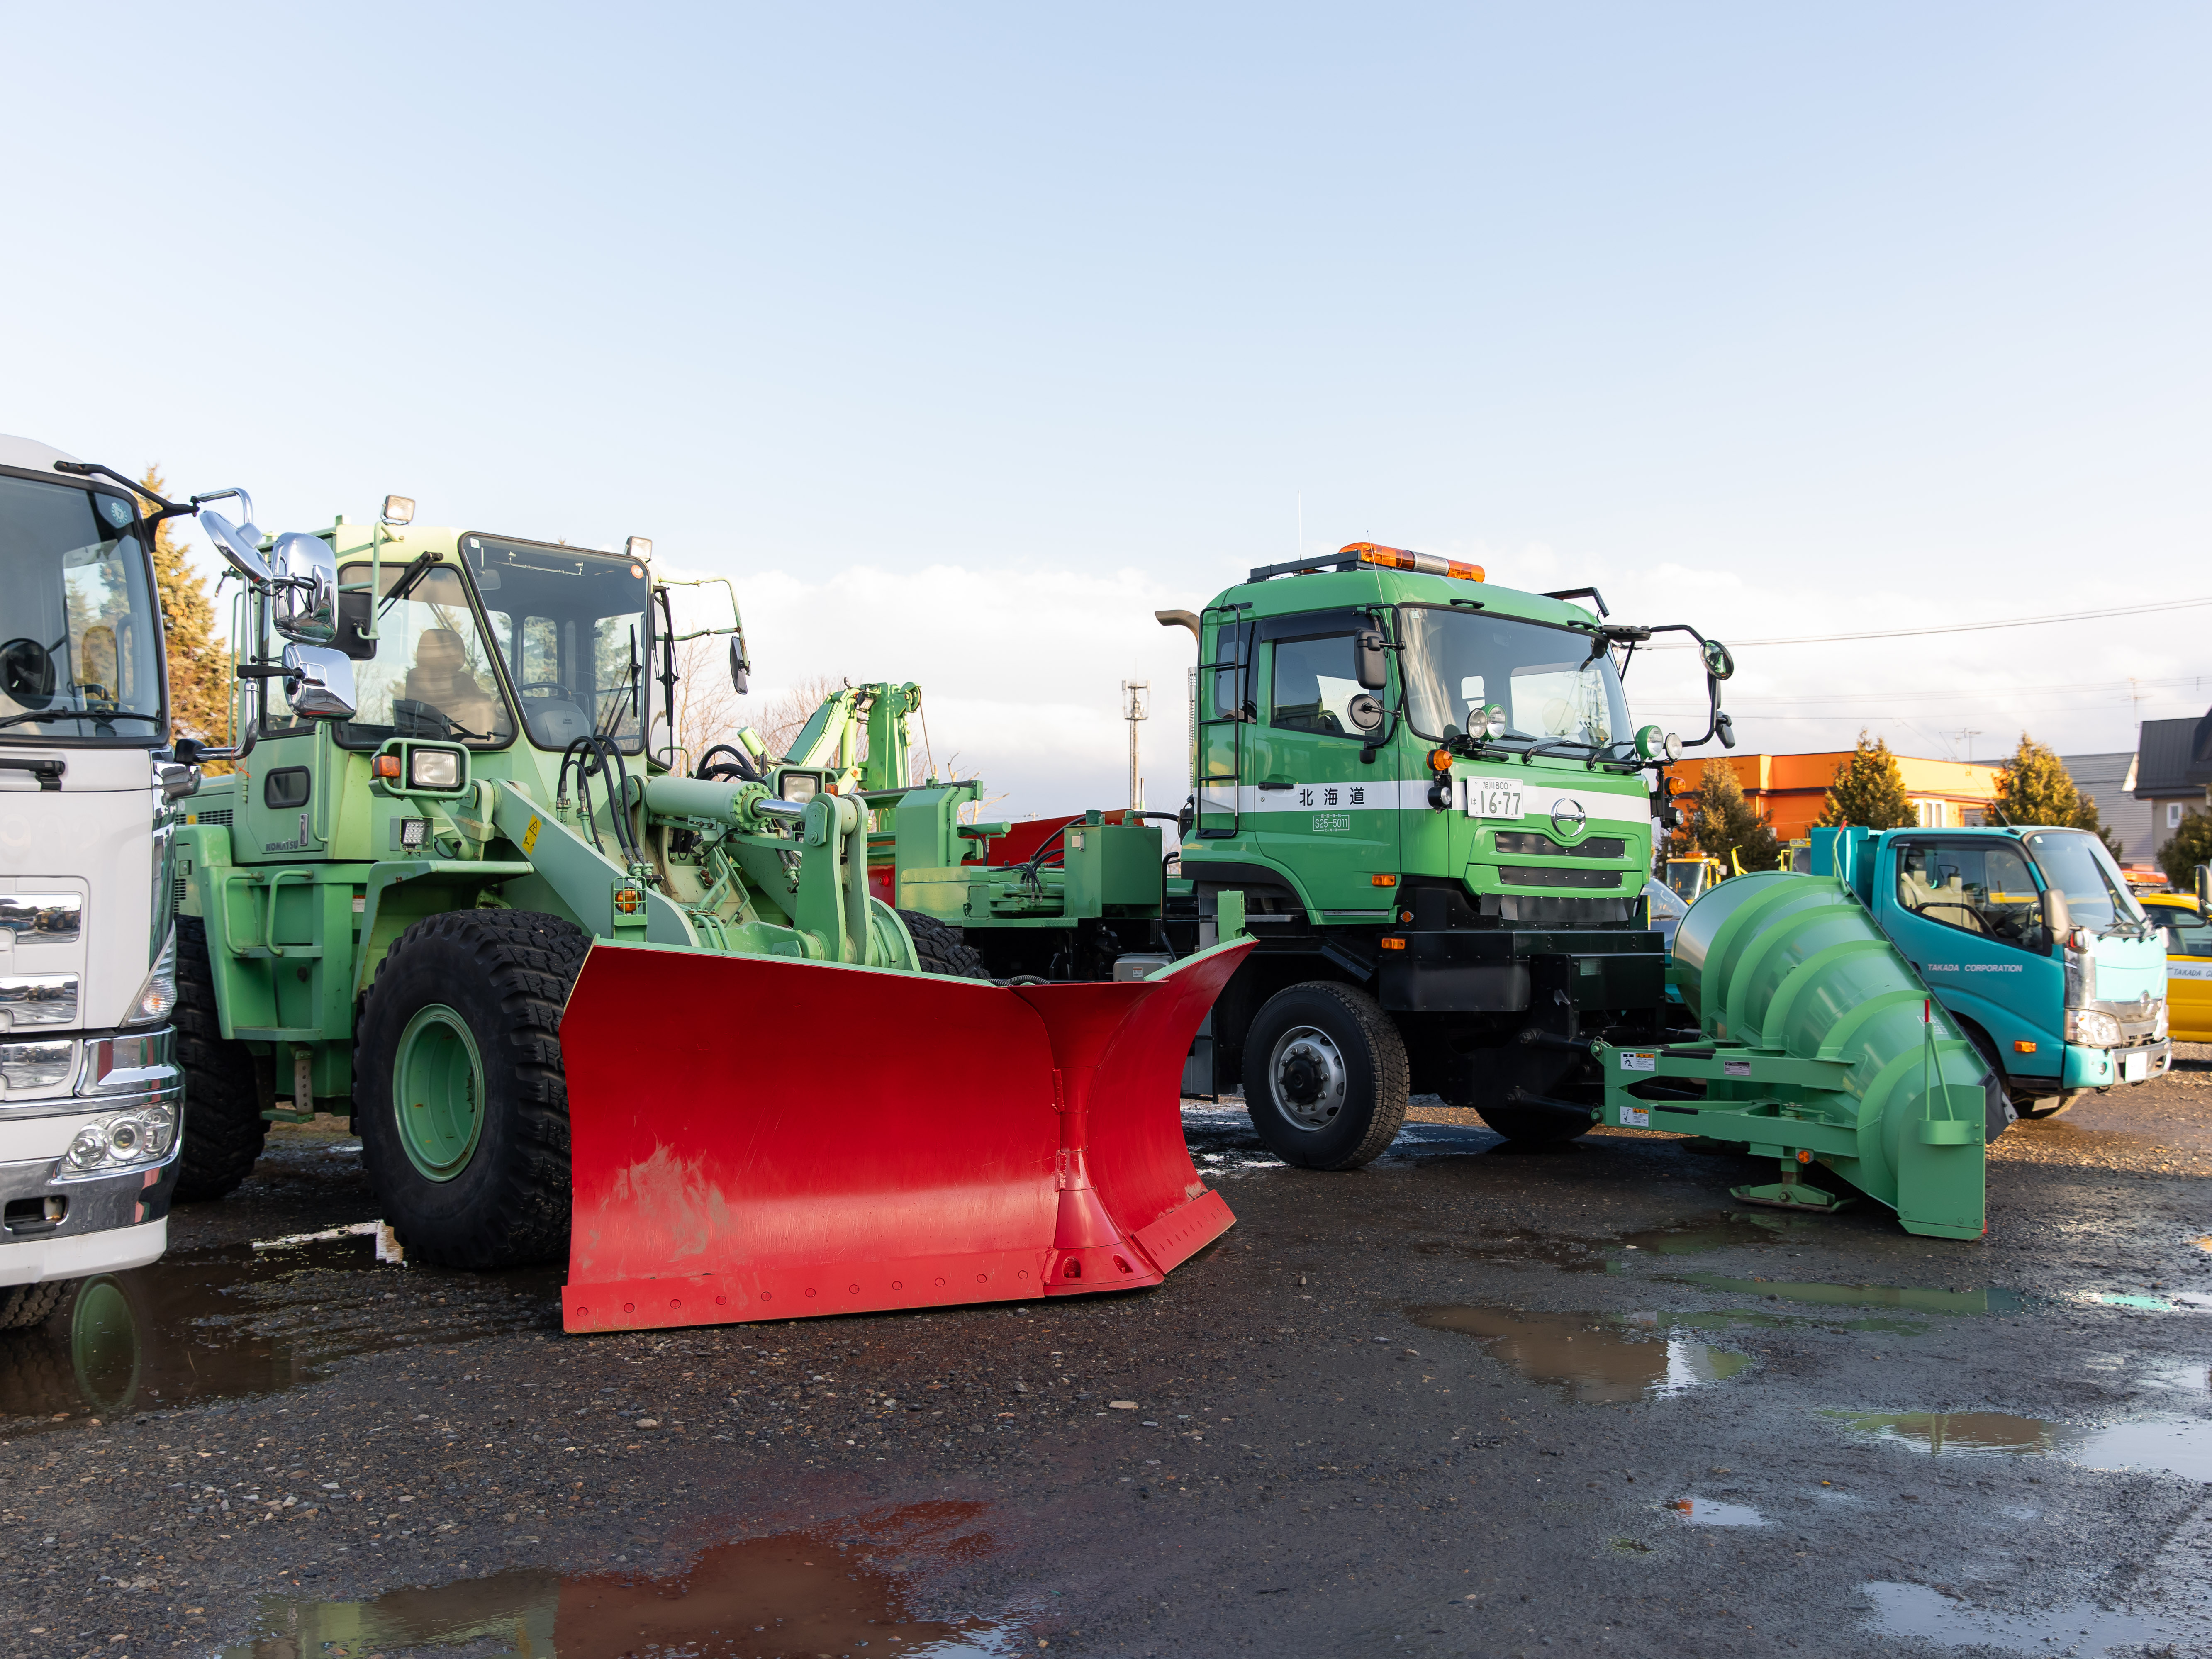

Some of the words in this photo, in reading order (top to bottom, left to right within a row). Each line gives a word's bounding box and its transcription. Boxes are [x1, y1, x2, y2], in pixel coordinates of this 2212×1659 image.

[1483, 781, 1508, 789] 旭川800
[1299, 787, 1364, 806] 北海道
[1481, 791, 1520, 815] 16-77
[1315, 818, 1347, 828] S25-5011
[266, 840, 298, 851] KOMATSU
